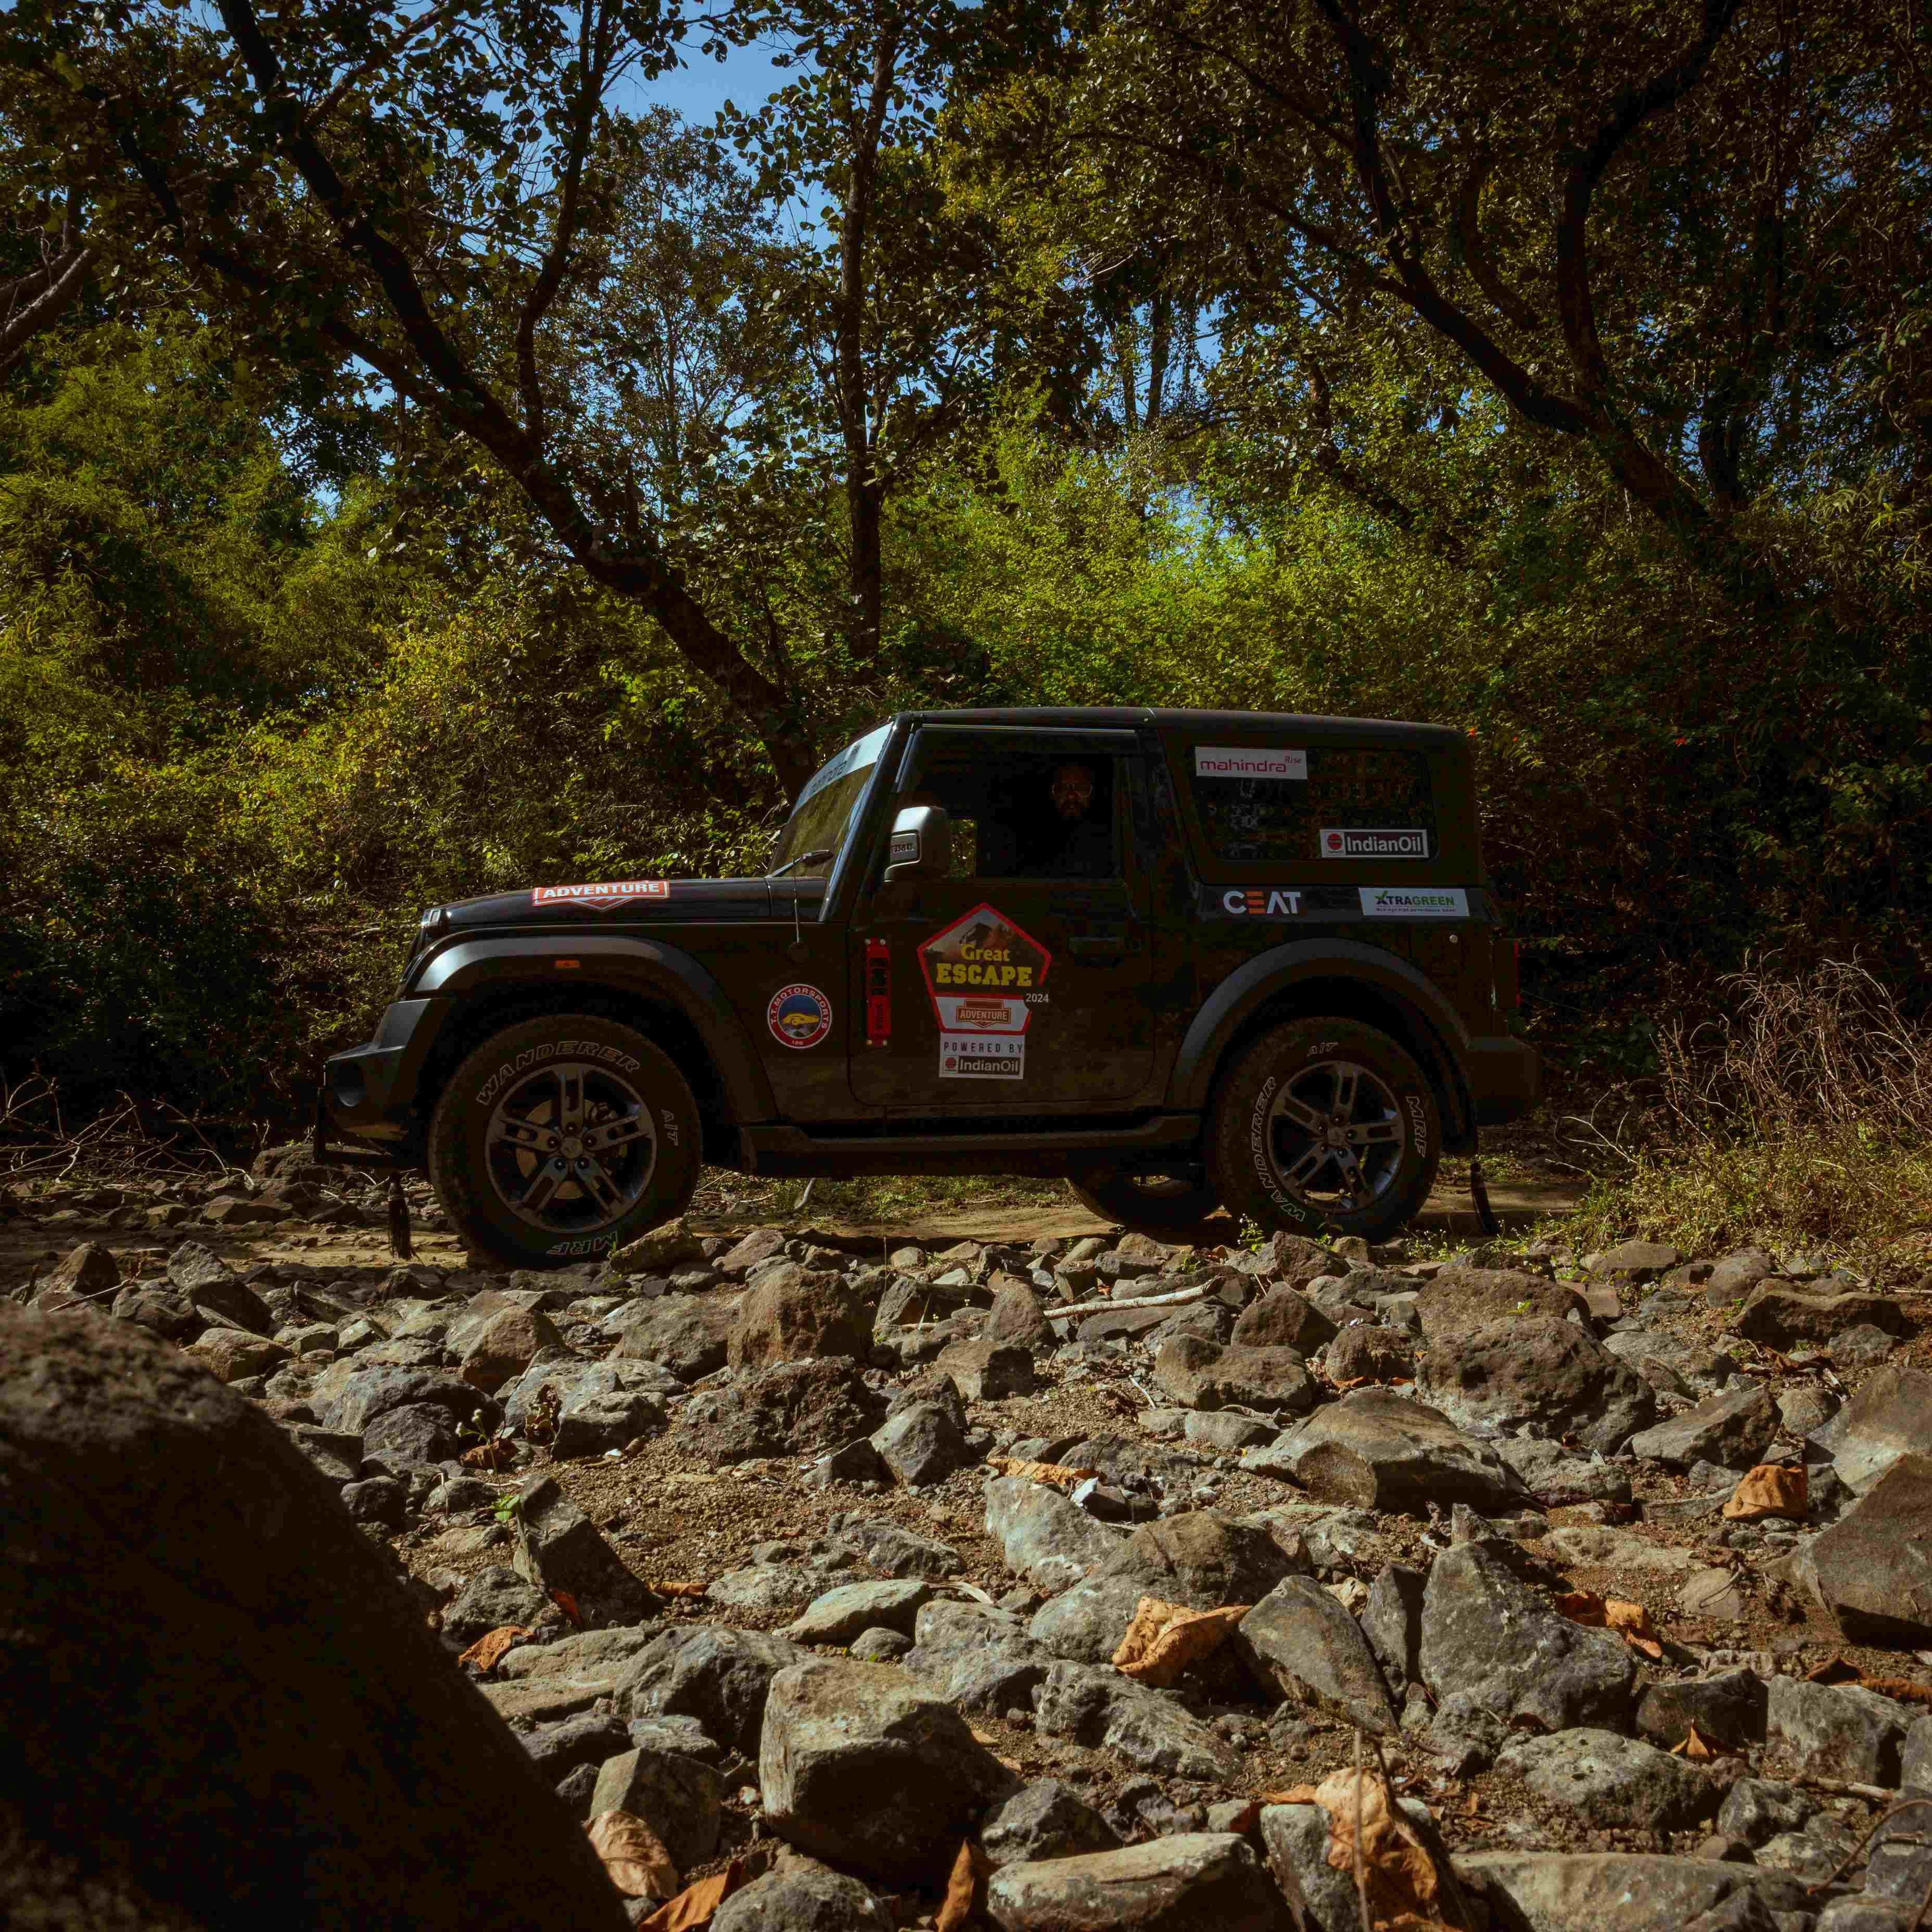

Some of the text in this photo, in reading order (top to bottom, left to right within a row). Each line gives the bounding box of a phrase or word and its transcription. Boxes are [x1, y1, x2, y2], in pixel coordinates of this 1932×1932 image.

[1200, 758, 1286, 772] mahindra
[1347, 836, 1422, 852] IndianOil
[543, 882, 659, 898] ADVENTURE
[1223, 891, 1301, 915] CEAT
[1374, 891, 1455, 906] XTRAGREEN
[961, 944, 1010, 961] Great
[936, 963, 1033, 987] ESCAPE
[1025, 993, 1050, 1003] 2024
[774, 987, 829, 1029] MOTORSPORTS
[959, 1009, 1008, 1020] ADVENTURE
[944, 1041, 1023, 1053] POWERED BY
[476, 1041, 641, 1105] WANDERER
[960, 1059, 1019, 1072] IndianOil
[1405, 1095, 1428, 1158] MRF
[1251, 1076, 1306, 1222] WANDERER
[546, 1231, 618, 1256] MRF
